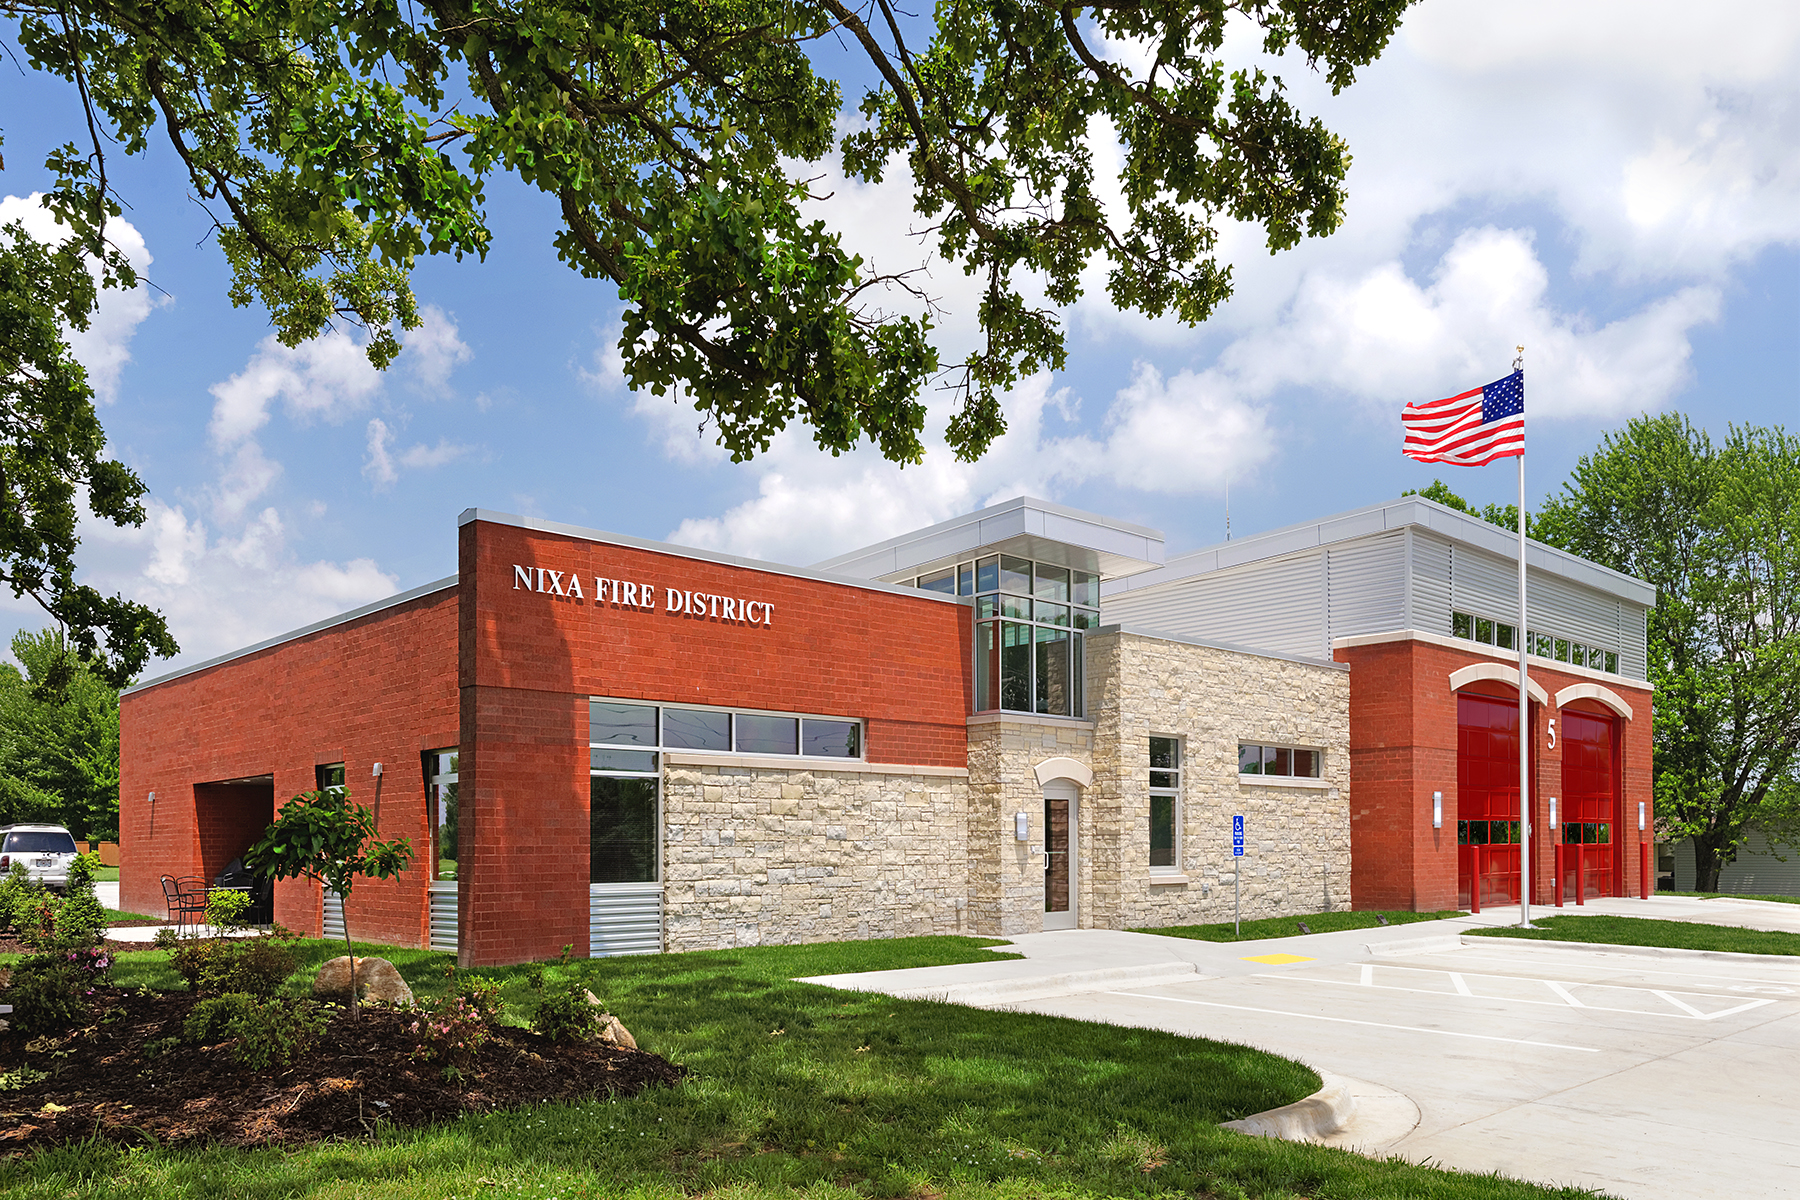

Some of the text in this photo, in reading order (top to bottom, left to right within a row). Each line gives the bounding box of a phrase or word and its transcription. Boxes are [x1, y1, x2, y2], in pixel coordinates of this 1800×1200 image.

[512, 564, 775, 625] NIXA FIRE DISTRICT
[1547, 718, 1556, 750] 5
